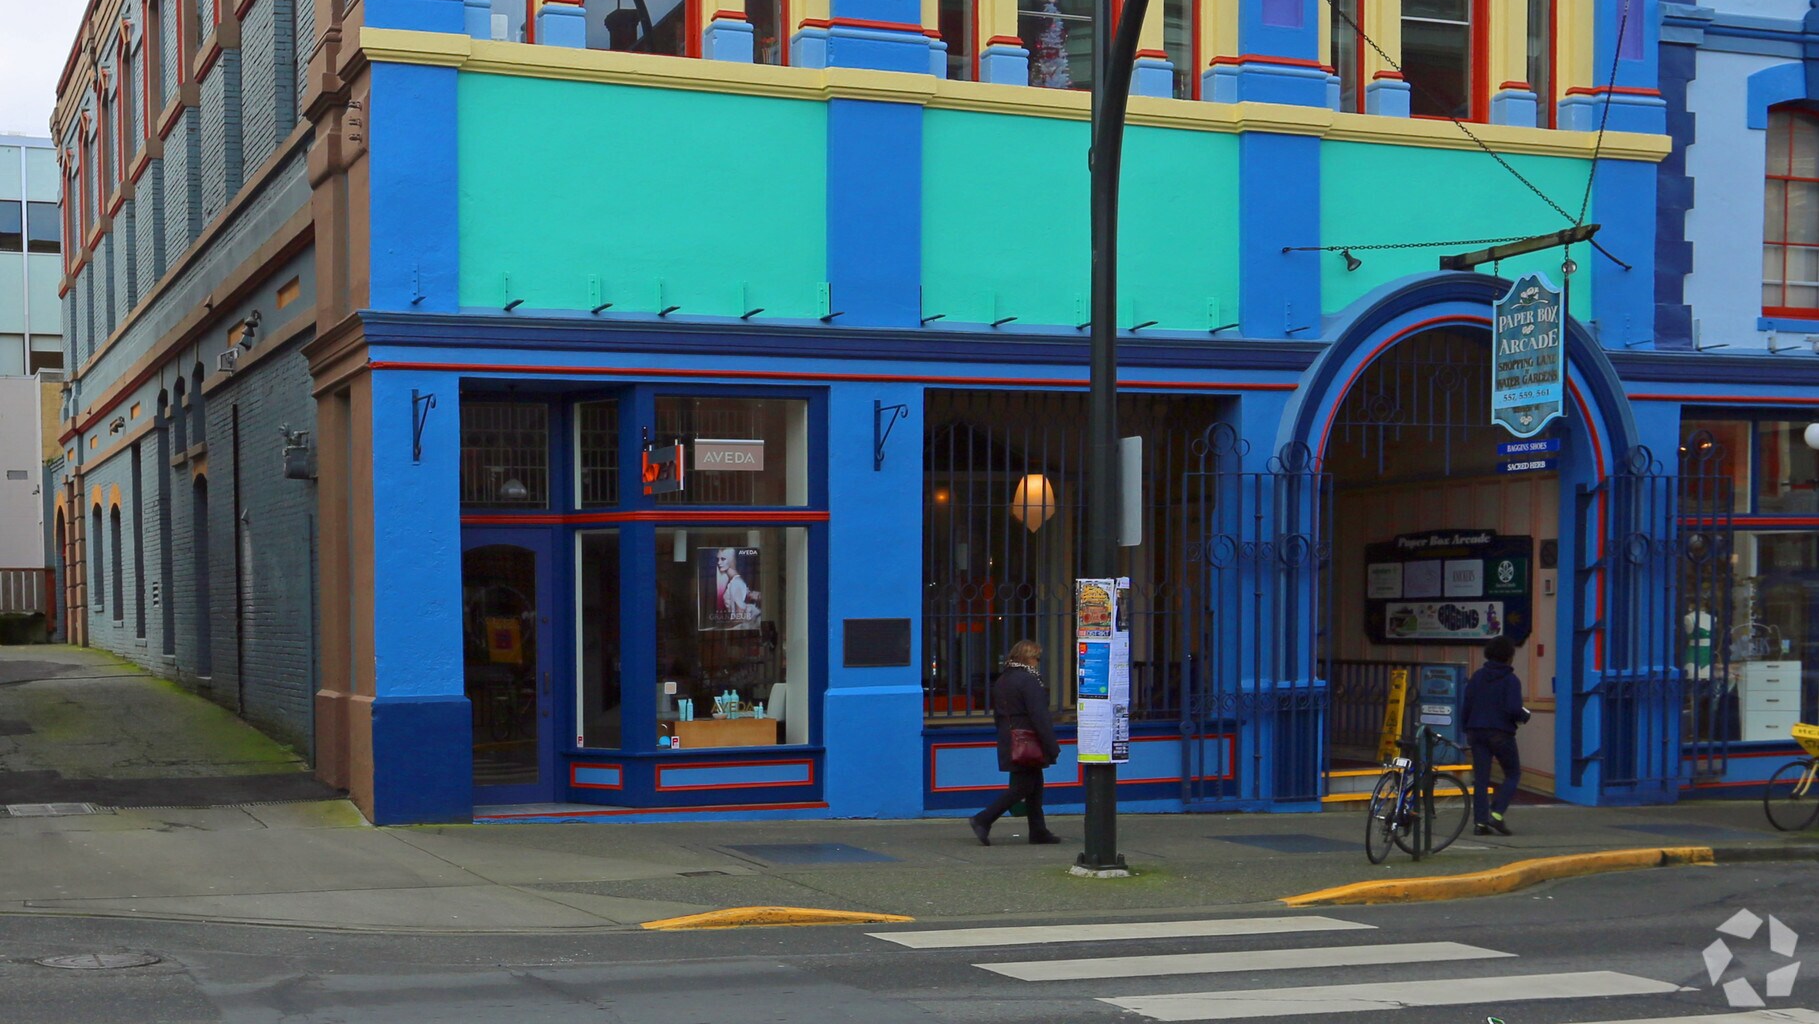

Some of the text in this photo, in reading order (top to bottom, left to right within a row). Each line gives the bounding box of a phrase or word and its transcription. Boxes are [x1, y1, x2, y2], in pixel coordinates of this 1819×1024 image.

[1499, 305, 1558, 333] PAPER BOX
[1499, 329, 1558, 355] ARCADE
[1529, 442, 1547, 451] SHOES
[703, 451, 755, 464] AVEDA
[1507, 460, 1546, 471] SACRED HERB
[1398, 537, 1428, 549] Paper
[1451, 532, 1492, 545] Arcade
[708, 612, 752, 621] GRANDEUR
[710, 701, 754, 714] AVEDA
